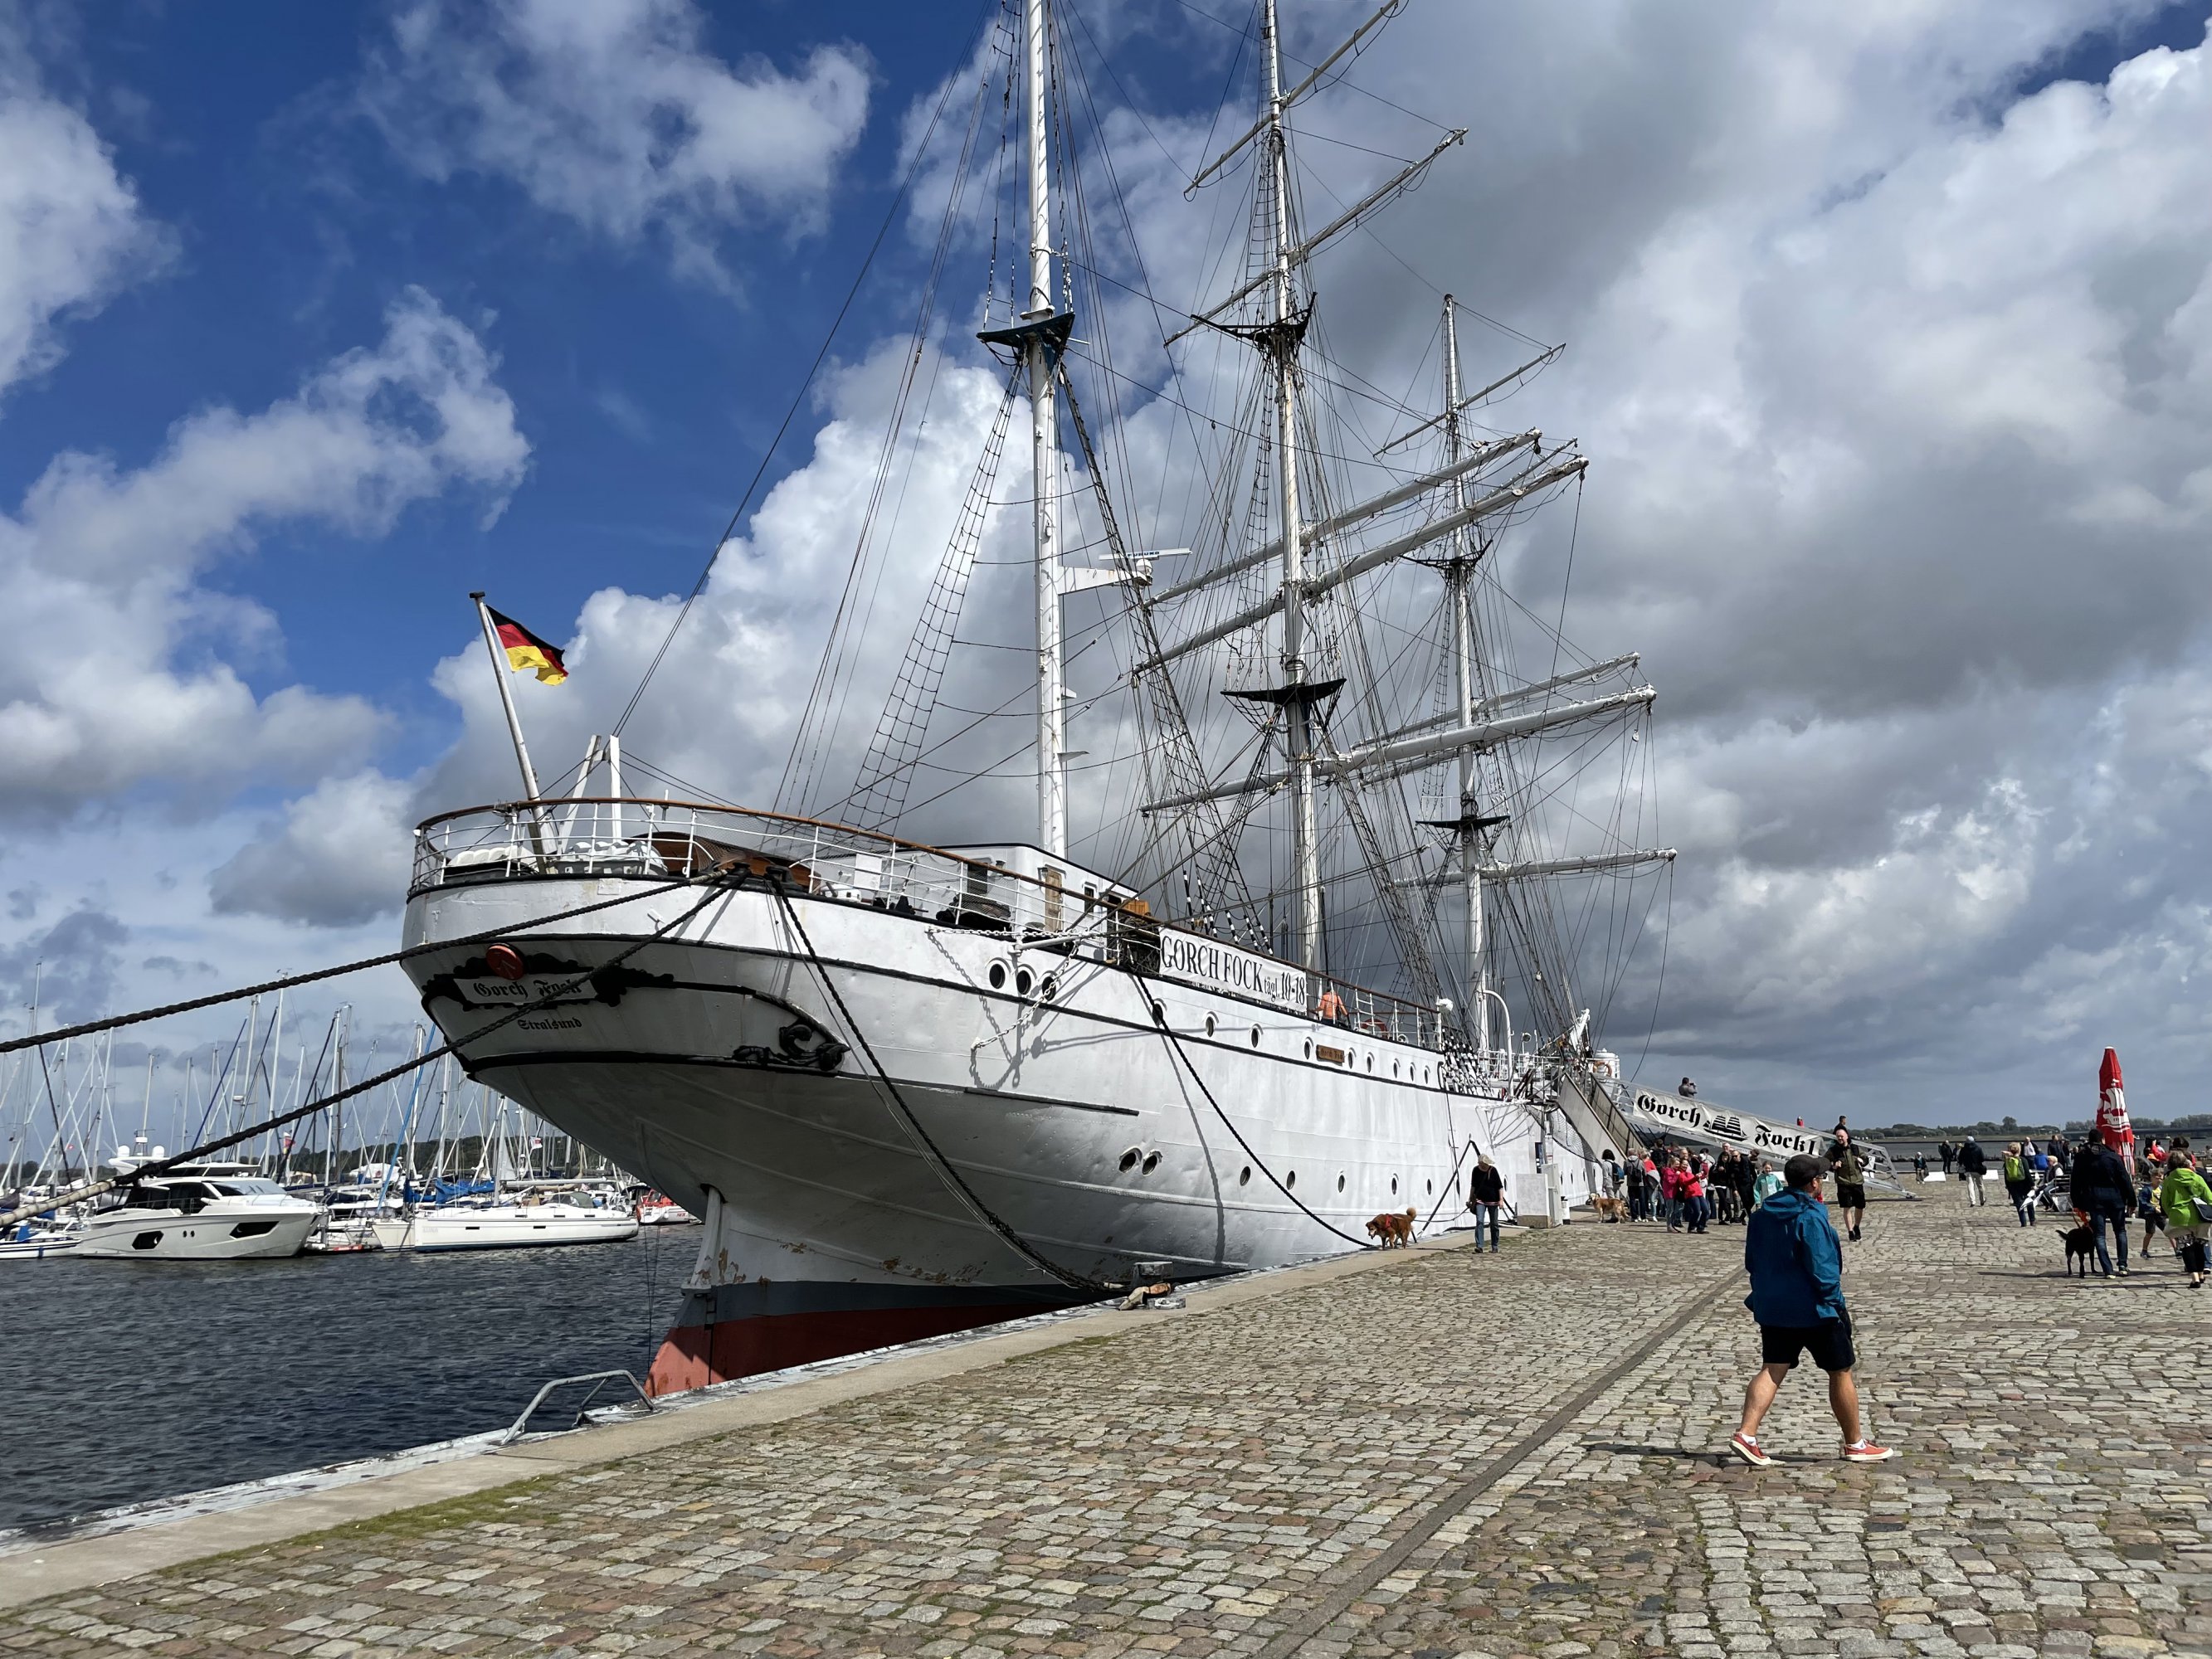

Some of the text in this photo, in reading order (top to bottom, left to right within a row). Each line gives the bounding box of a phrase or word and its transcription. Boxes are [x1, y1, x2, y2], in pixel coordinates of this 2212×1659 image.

[1161, 936, 1306, 1005] GORCH FOCK tägl. 10-18
[473, 981, 529, 1000] Gorch
[517, 1017, 582, 1030] Stralsund
[1637, 1094, 1701, 1128] Gorch
[1755, 1124, 1805, 1152] Fock
